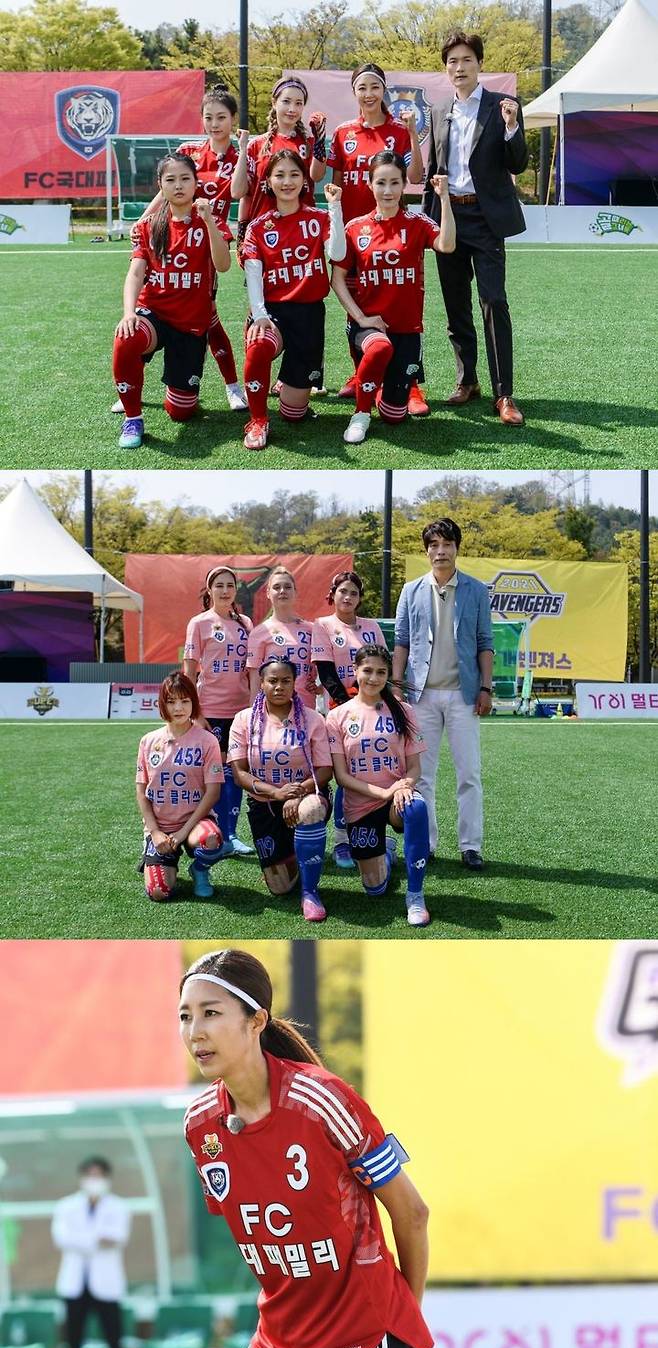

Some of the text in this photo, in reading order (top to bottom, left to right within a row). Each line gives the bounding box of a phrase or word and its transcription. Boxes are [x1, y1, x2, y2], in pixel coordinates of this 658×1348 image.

[298, 144, 307, 160] 8
[385, 136, 396, 151] 3
[215, 161, 232, 179] 12
[186, 227, 204, 248] 19
[298, 218, 321, 240] 10
[400, 228, 407, 245] 1
[281, 245, 310, 264] FC
[371, 250, 401, 266] FC
[268, 267, 290, 286] 국대
[359, 270, 380, 288] 국대
[489, 592, 564, 614] AVENGERS
[237, 627, 249, 641] 2
[227, 644, 247, 657] FC
[287, 646, 308, 659] FC
[375, 715, 399, 735] 45
[361, 737, 389, 753] FC
[174, 748, 203, 767] 452
[261, 751, 290, 766] FC
[160, 772, 187, 787] FC
[350, 826, 379, 849] 456
[286, 1144, 310, 1191] 3
[239, 1202, 293, 1238] FC
